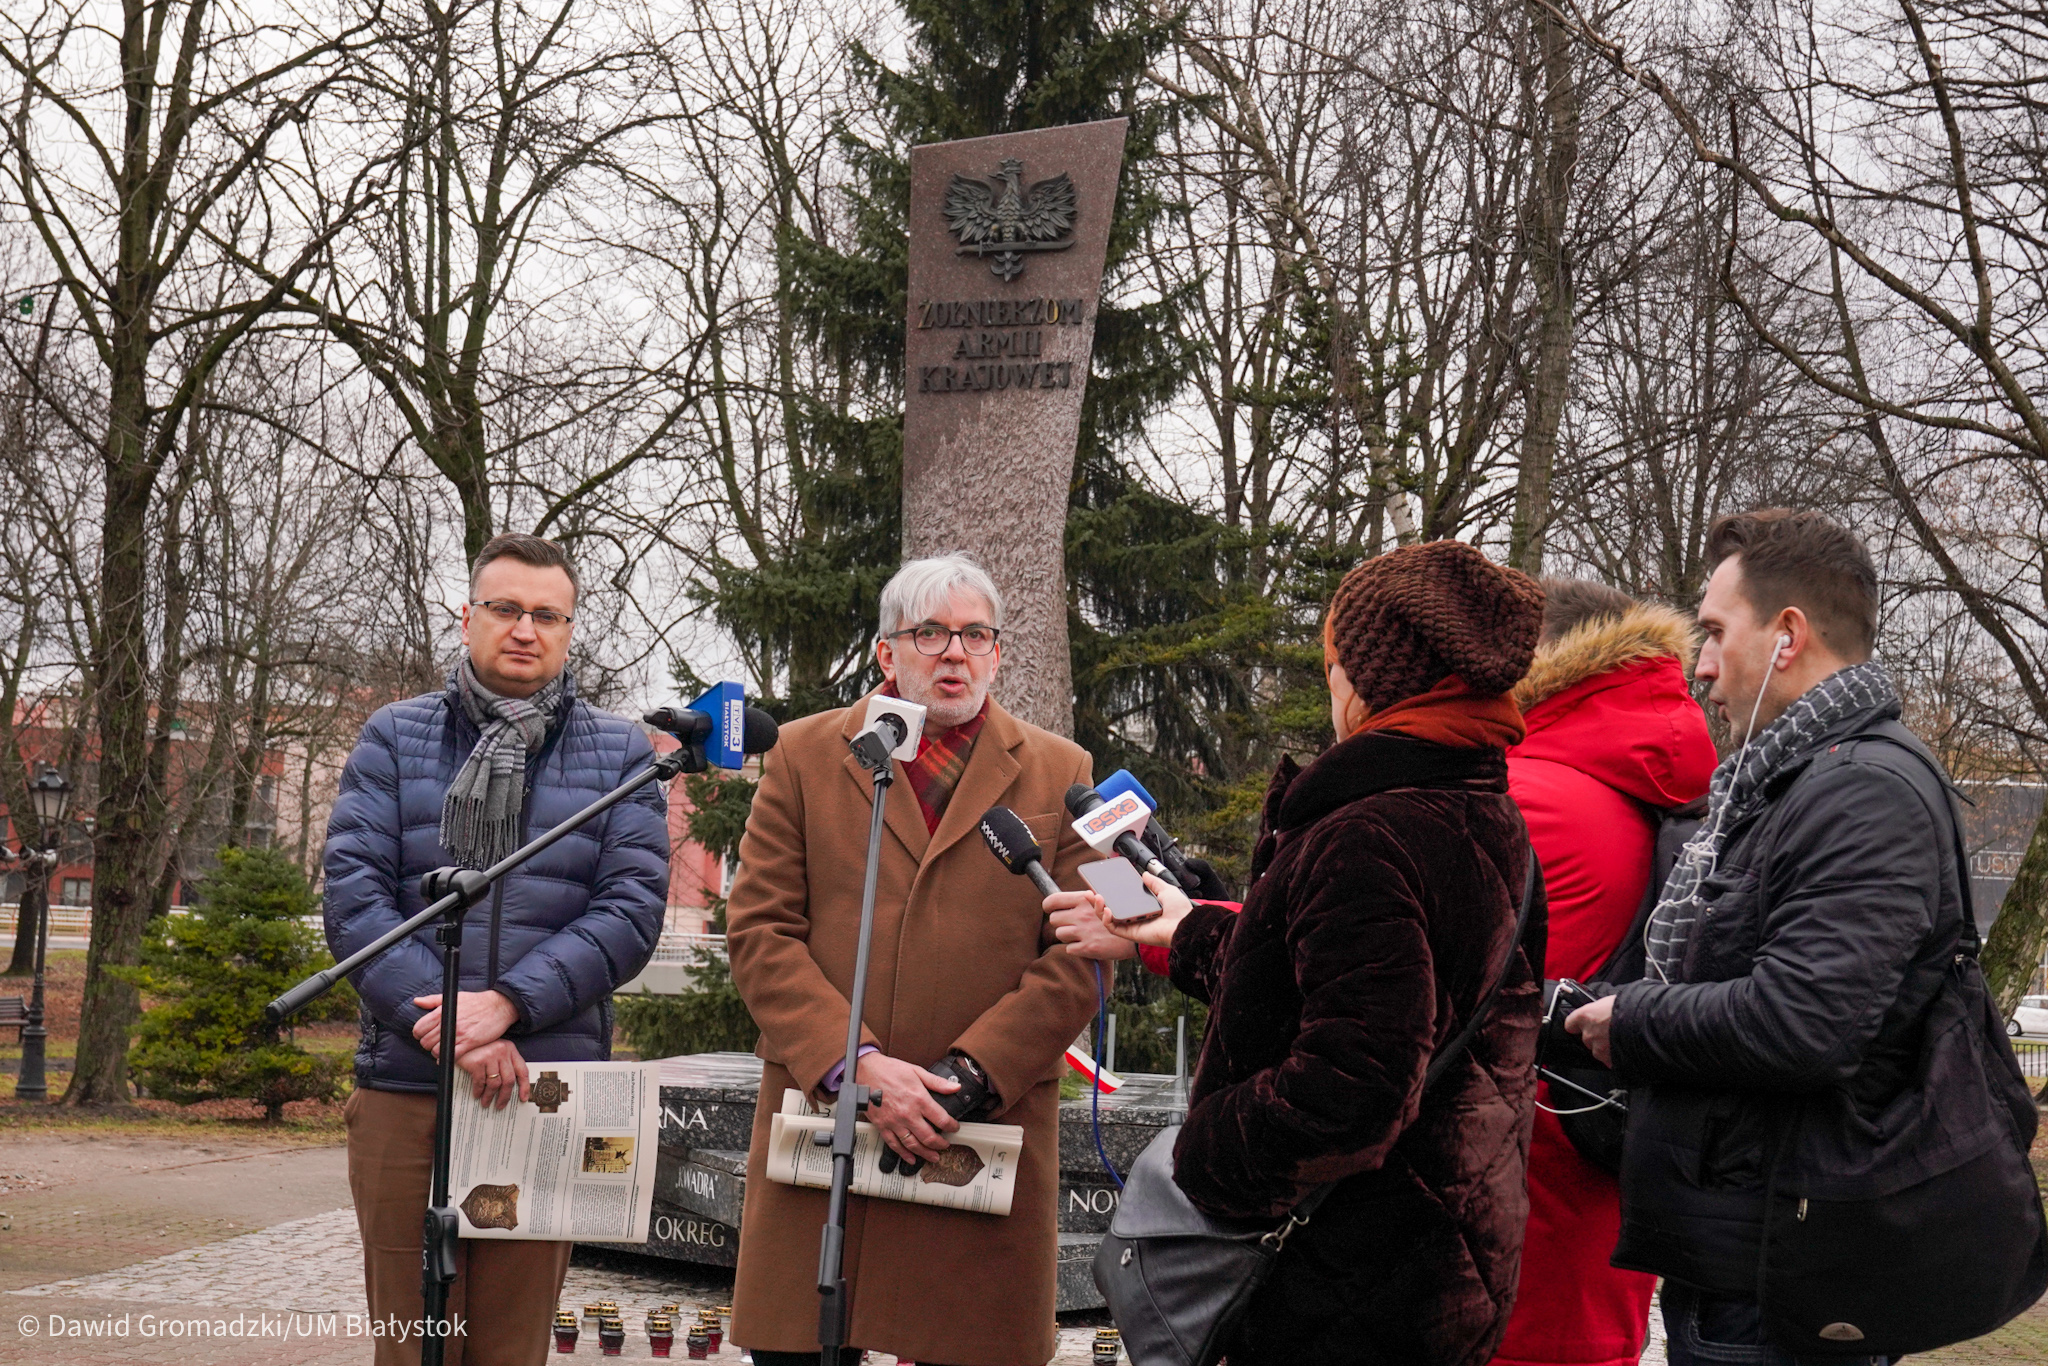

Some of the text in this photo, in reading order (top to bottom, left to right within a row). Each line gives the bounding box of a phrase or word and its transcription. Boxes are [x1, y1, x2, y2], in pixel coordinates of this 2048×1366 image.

[953, 330, 1042, 359] ARMII
[918, 362, 1072, 392] KRAJOWEJ
[733, 706, 741, 734] TVP
[1088, 798, 1138, 832] eska
